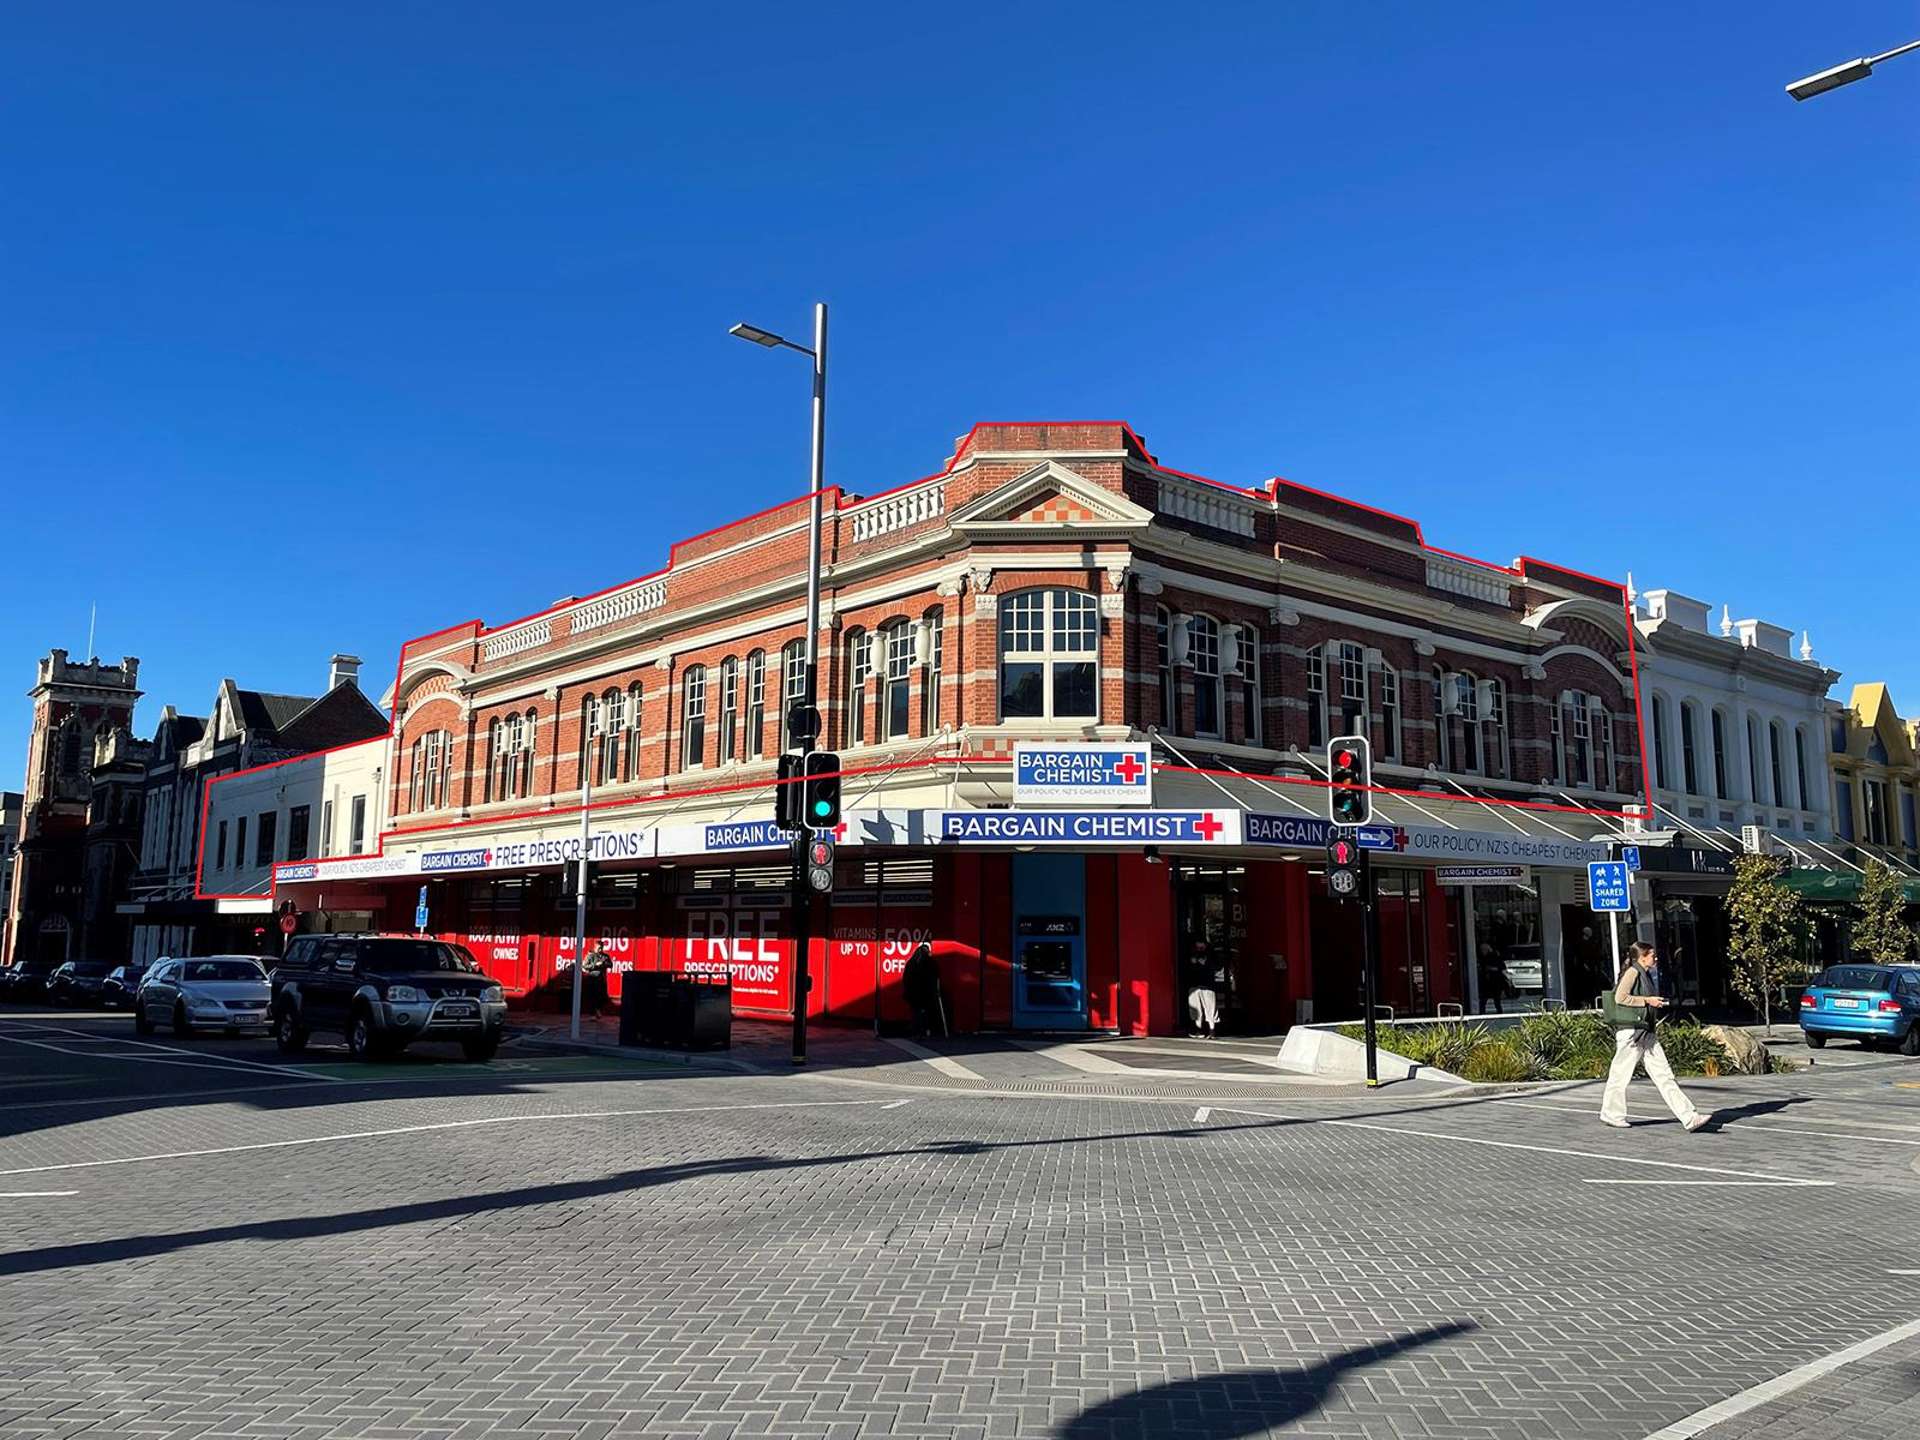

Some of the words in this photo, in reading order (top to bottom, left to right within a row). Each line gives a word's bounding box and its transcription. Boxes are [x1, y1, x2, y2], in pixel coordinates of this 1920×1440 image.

[1020, 754, 1103, 768] BARGAIN
[1034, 769, 1112, 783] CHEMIST
[708, 825, 764, 846] BARGAIN
[948, 816, 1065, 837] BARGAIN
[1073, 816, 1186, 837] CHEMIST
[1250, 819, 1323, 842] BARGAIN
[495, 844, 525, 867] FREE
[1415, 833, 1439, 849] OUR
[1512, 842, 1560, 859] CHEAPEST
[1564, 846, 1601, 861] CHEMIST
[422, 852, 452, 869] BARGAIN
[452, 849, 484, 868] CHEMIST
[1439, 868, 1475, 877] BARGAIN
[1476, 868, 1512, 876] CHEMIST
[1595, 888, 1625, 897] SHARED
[1600, 899, 1620, 907] ZONE
[601, 925, 629, 952] BIG
[685, 911, 780, 962] FREE
[833, 927, 877, 940] VITAMINS
[883, 928, 933, 956] 50%
[840, 943, 854, 956] UP
[856, 943, 869, 956] TO
[882, 959, 905, 973] OFF
